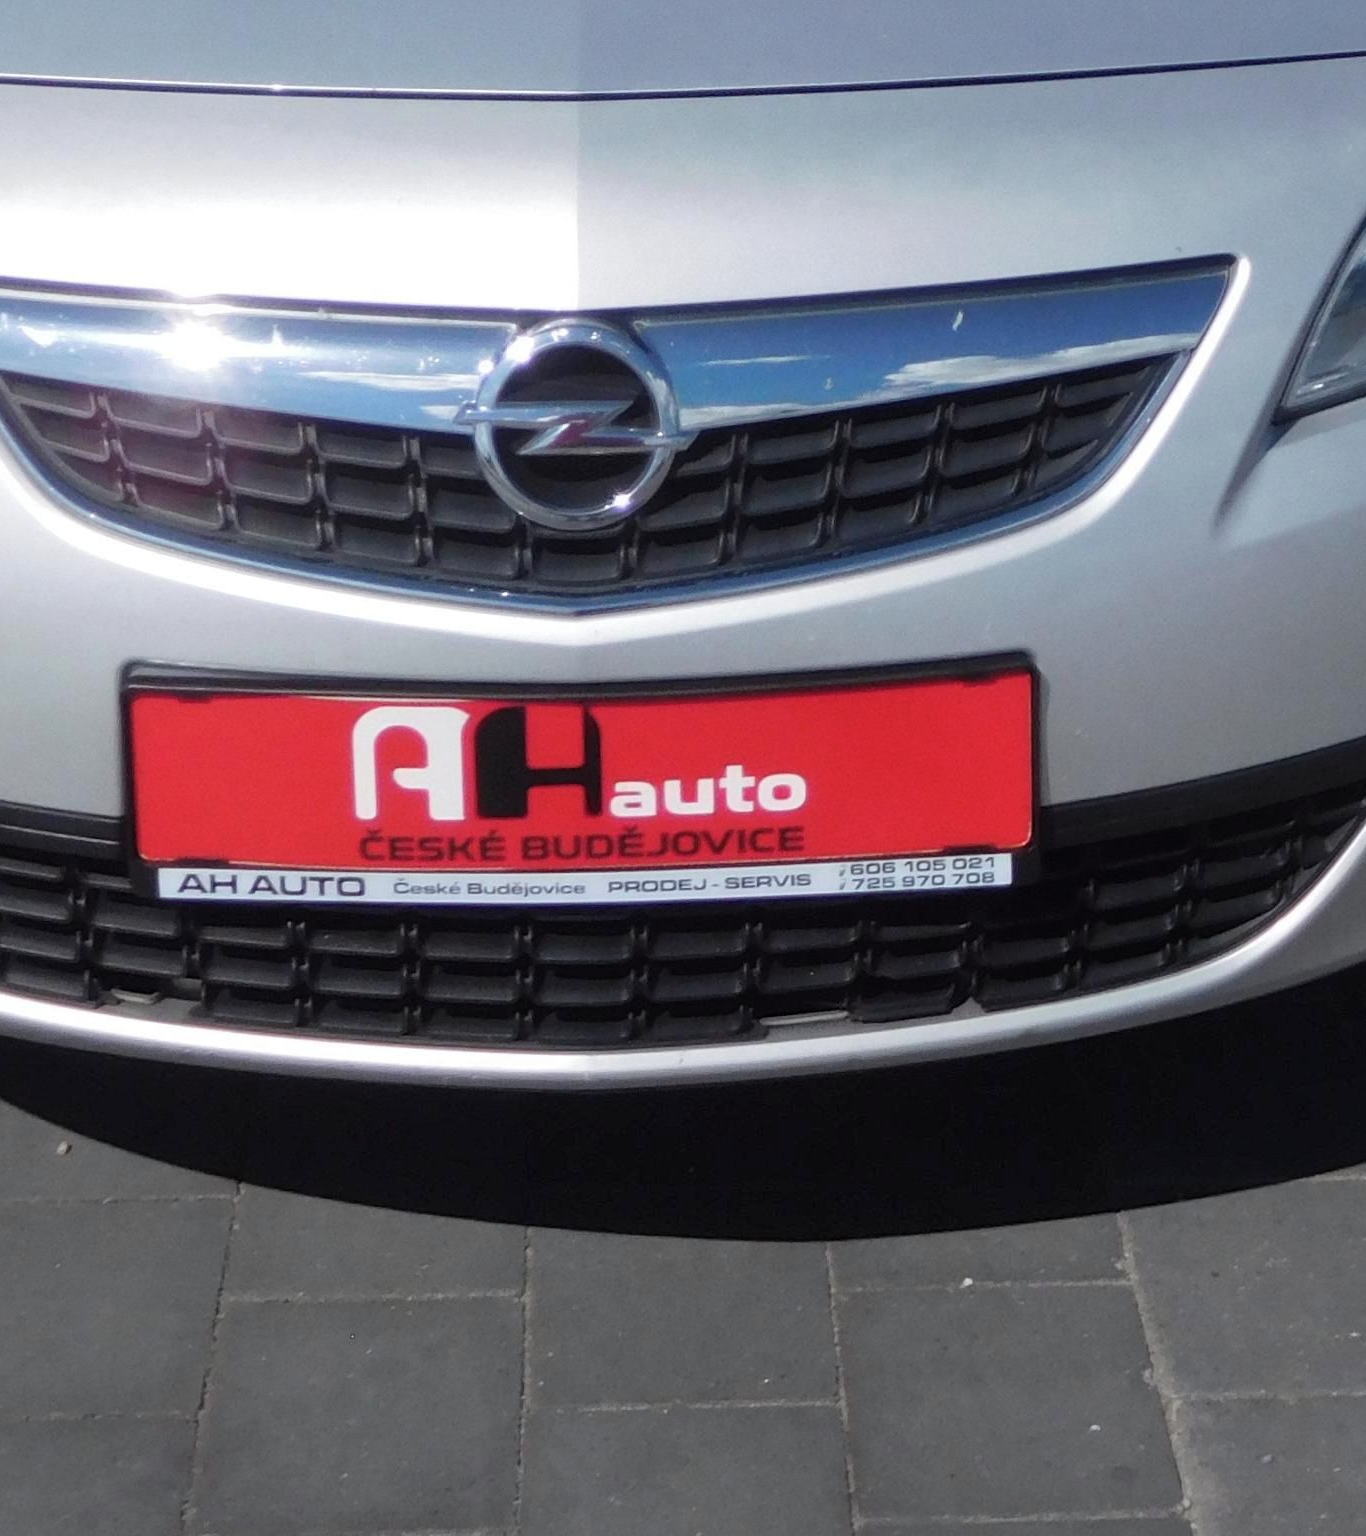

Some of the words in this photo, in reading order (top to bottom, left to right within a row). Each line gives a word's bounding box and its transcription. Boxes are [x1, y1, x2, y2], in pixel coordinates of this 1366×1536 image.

[358, 828, 508, 863] ČESKÉ
[520, 825, 805, 861] BUDĚJOVICE
[850, 862, 896, 876] 606
[903, 859, 947, 873] 105
[951, 856, 995, 870] 021
[177, 874, 238, 895] AH
[248, 875, 367, 897] AUTO
[393, 878, 461, 895] České
[466, 881, 586, 898] Budějovice
[608, 878, 707, 894] PRODEJ
[724, 873, 812, 890] SERVIS
[851, 876, 896, 891] 725
[902, 874, 946, 888] 970
[951, 871, 996, 885] 708
